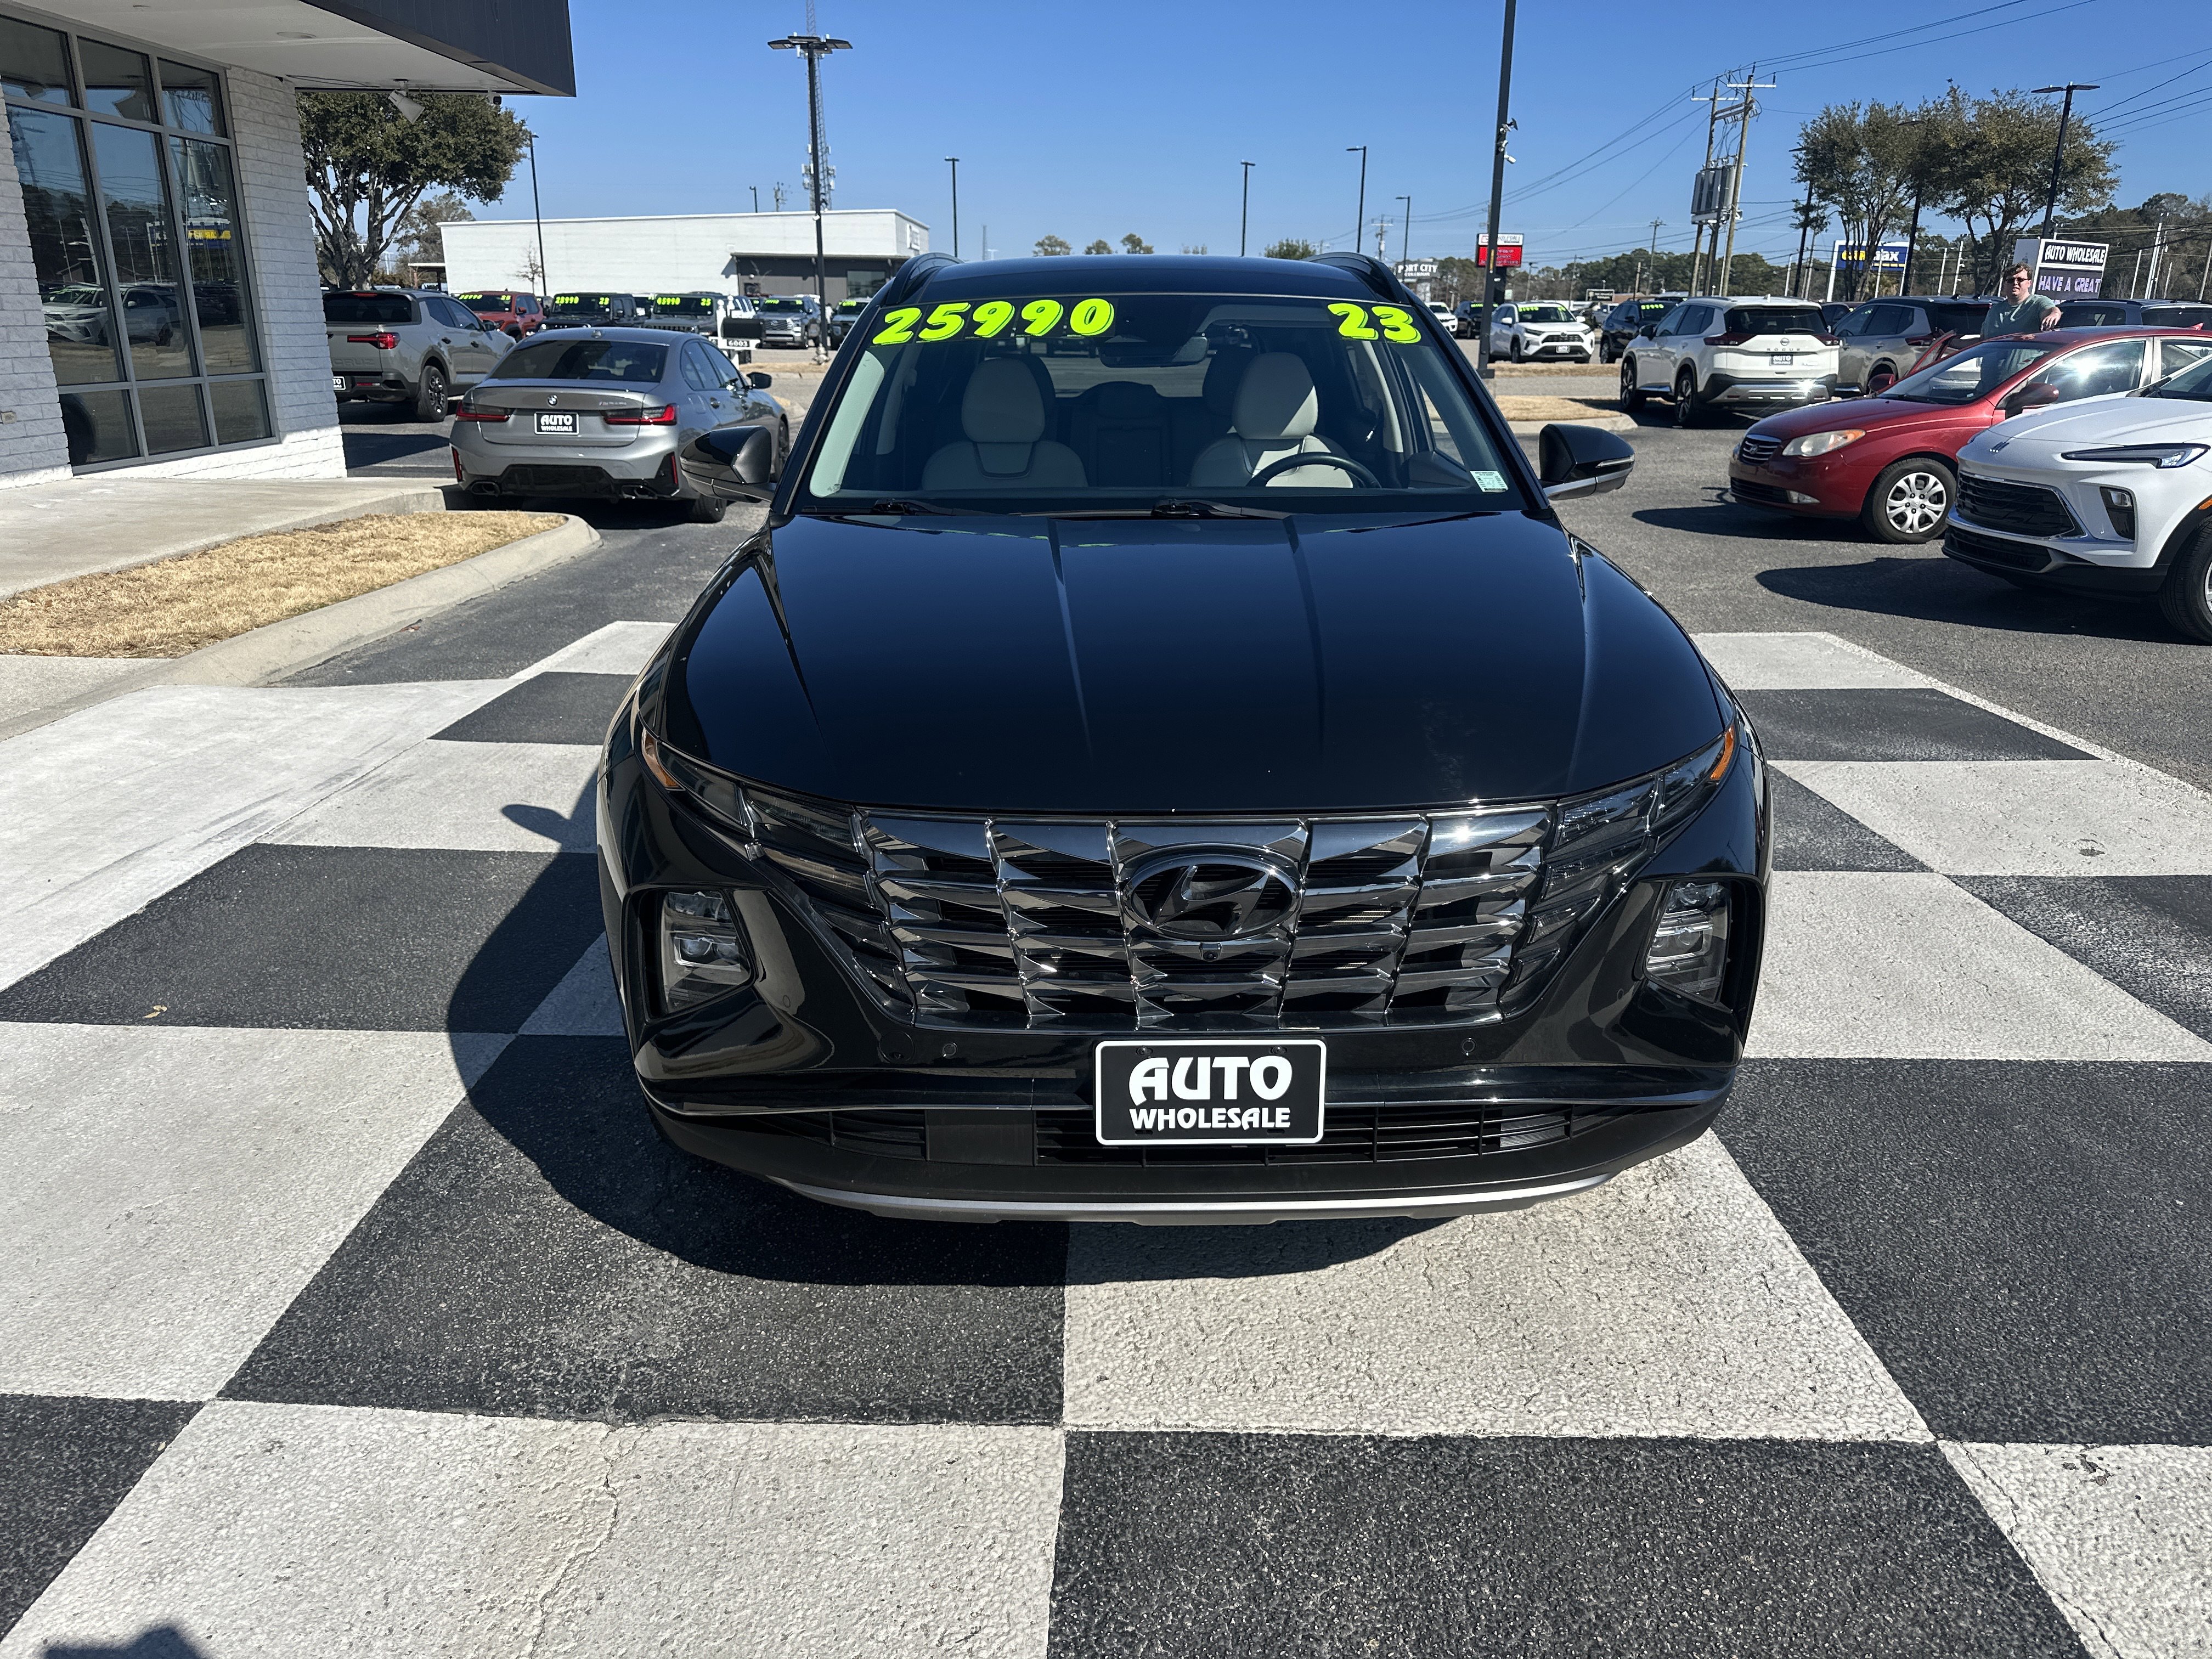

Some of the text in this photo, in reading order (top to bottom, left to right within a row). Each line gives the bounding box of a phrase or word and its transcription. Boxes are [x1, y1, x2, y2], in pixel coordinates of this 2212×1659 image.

[2045, 245, 2106, 263] AUTO WHOLESALE
[1420, 264, 1438, 273] CITY
[2038, 275, 2101, 292] HAVE A GREAT
[872, 298, 1421, 345] 25990 23
[540, 415, 573, 426] AUTO
[1128, 1056, 1293, 1106] AUTO
[1129, 1107, 1290, 1131] WHOLESALE
